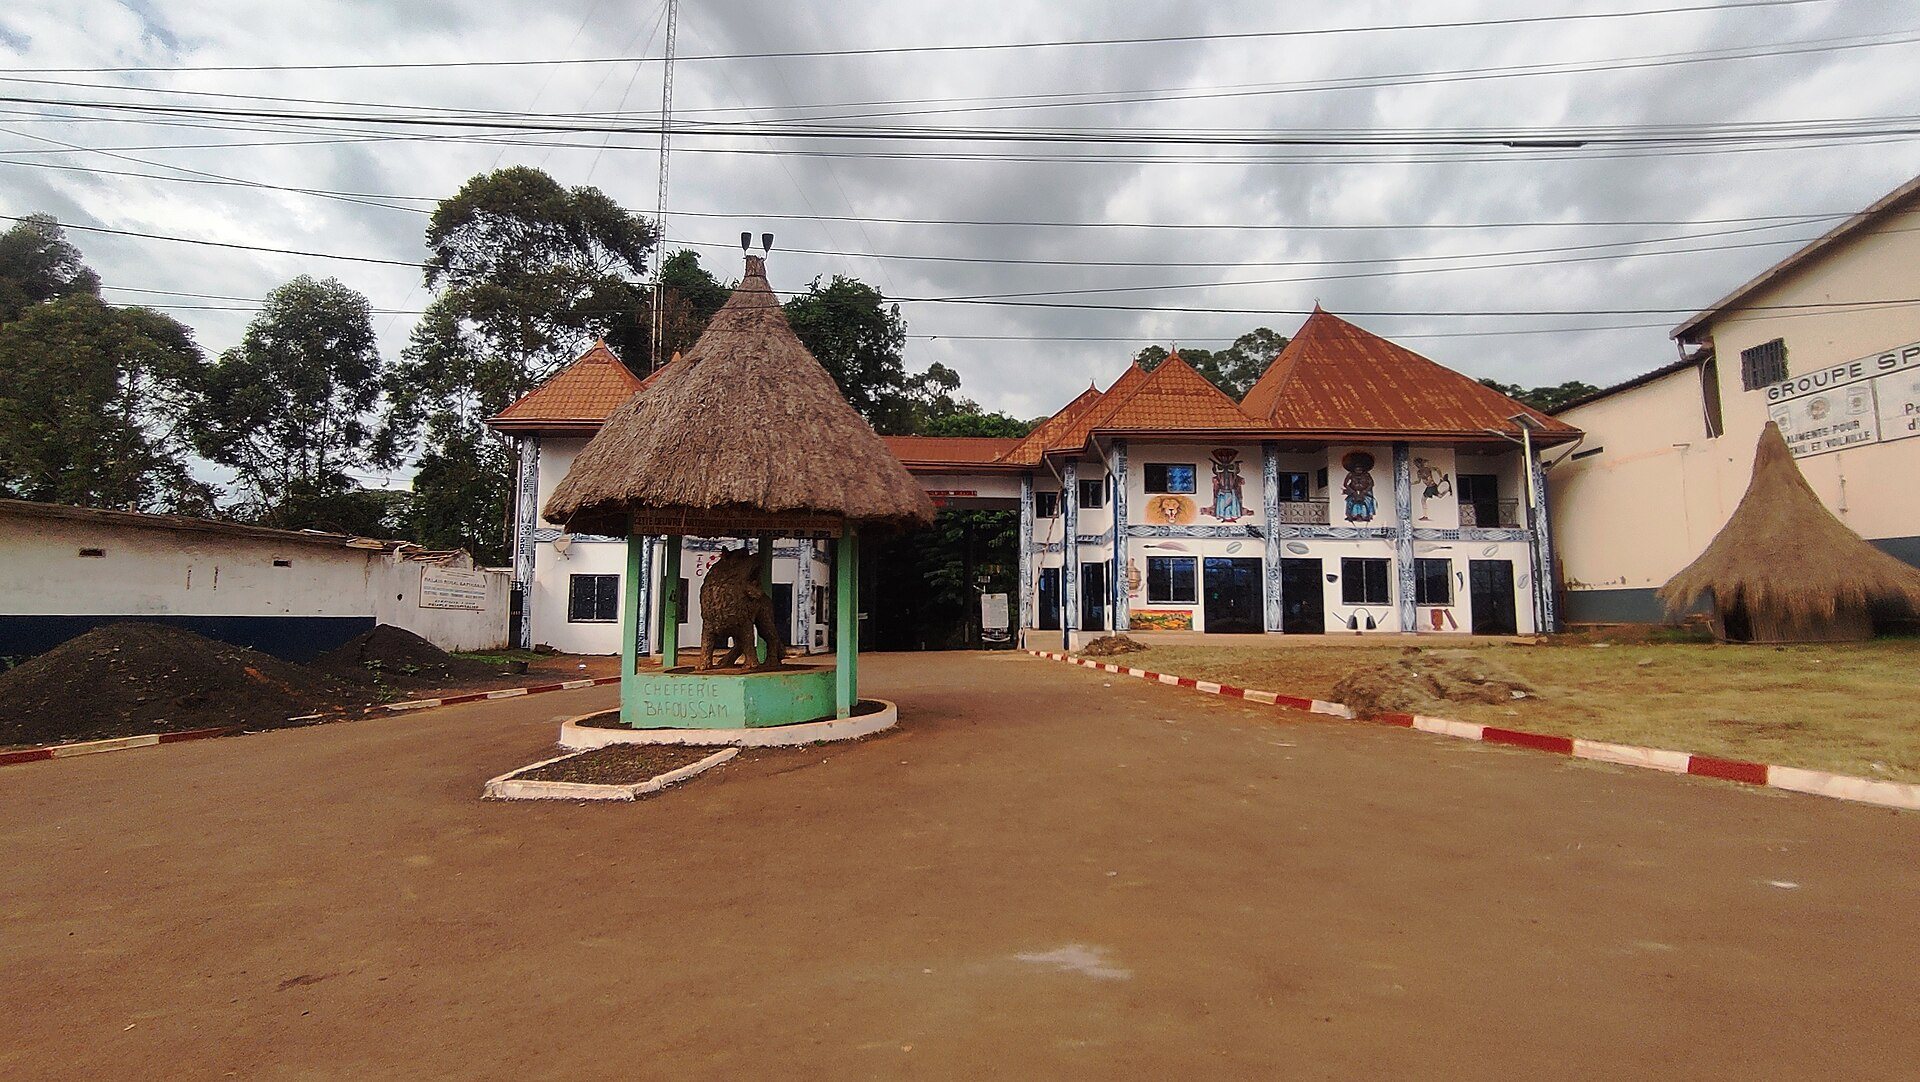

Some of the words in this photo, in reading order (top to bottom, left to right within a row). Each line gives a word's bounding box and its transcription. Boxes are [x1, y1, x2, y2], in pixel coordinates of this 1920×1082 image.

[1768, 363, 1863, 400] GROUPE
[1832, 420, 1860, 435] POUR
[1811, 441, 1822, 452] ET
[1824, 431, 1871, 449] VOLAILLE
[644, 683, 719, 698] CHEFFERIE
[643, 700, 728, 719] BAFOUSSAM
